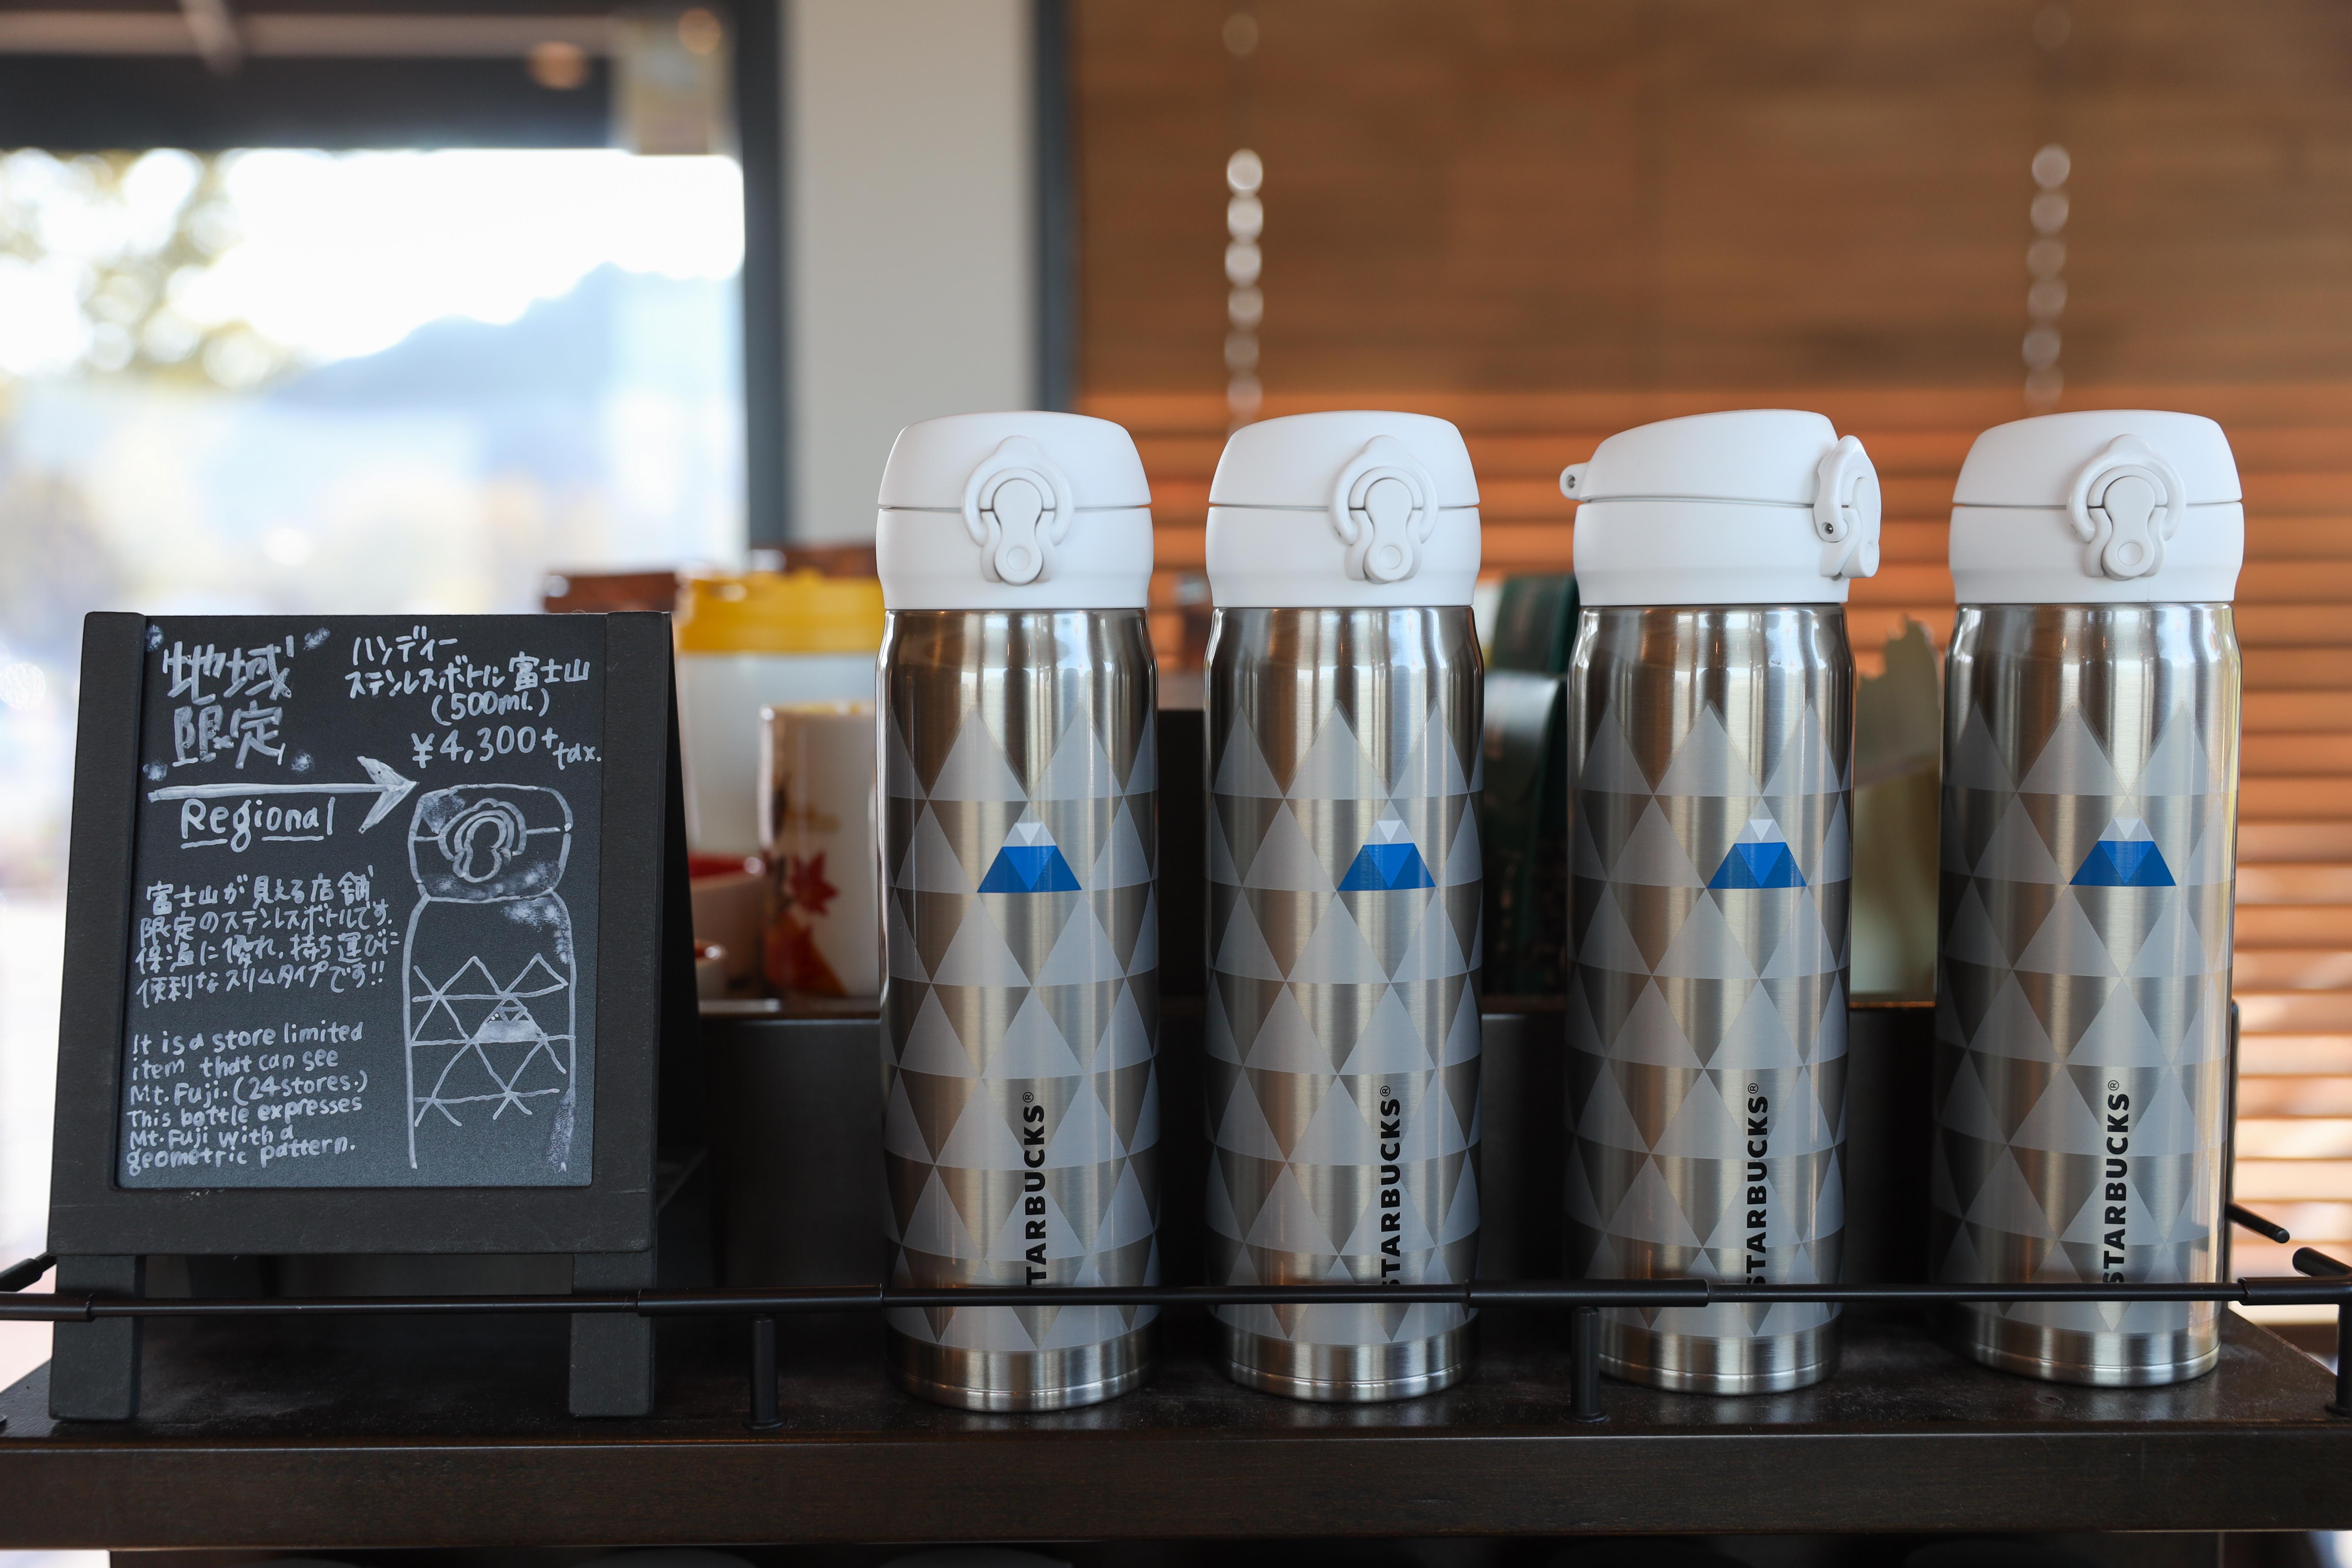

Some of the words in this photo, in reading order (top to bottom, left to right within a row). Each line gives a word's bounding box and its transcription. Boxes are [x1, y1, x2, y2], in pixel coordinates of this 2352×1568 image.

[353, 625, 458, 666] ハンディー
[162, 635, 294, 706] 地域
[172, 700, 286, 769] 限定
[181, 796, 336, 853] Regional
[146, 864, 374, 916] 富士山が見える店舗
[133, 1034, 152, 1055] It
[163, 1030, 185, 1055] is
[189, 1033, 204, 1051] a
[213, 1029, 276, 1053] store
[285, 1019, 363, 1043] limited
[133, 1057, 185, 1080] item
[200, 1055, 250, 1078] that
[259, 1053, 294, 1071] can
[302, 1049, 338, 1071] see
[127, 1109, 171, 1127] This
[180, 1105, 249, 1127] bottle
[257, 1096, 362, 1124] expresses
[127, 1145, 248, 1176] geometric
[260, 1136, 356, 1168] pattern.
[218, 1125, 273, 1148] with
[280, 1124, 294, 1140] a
